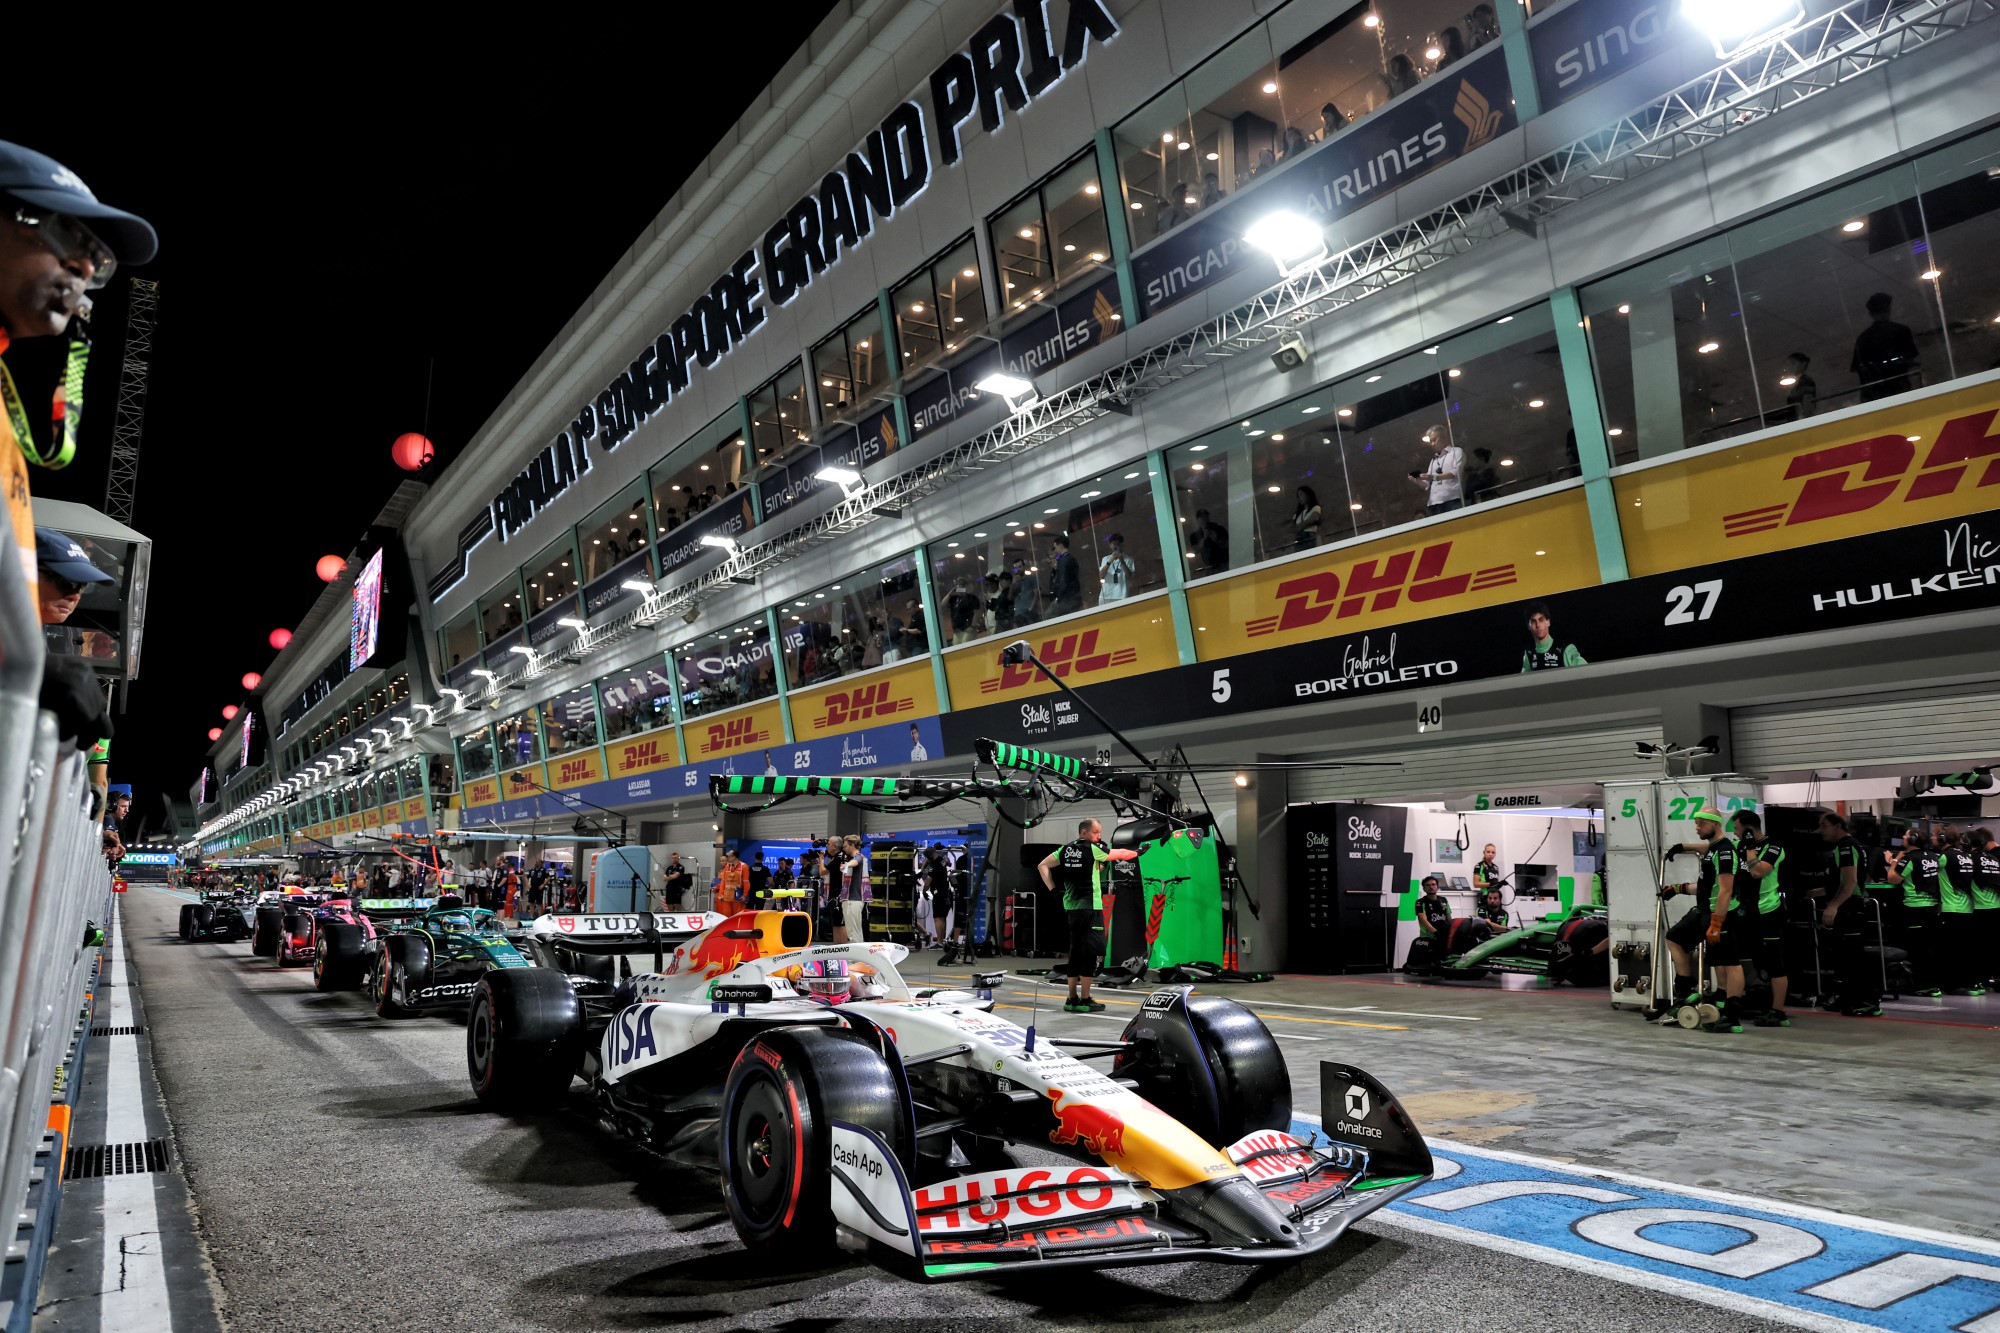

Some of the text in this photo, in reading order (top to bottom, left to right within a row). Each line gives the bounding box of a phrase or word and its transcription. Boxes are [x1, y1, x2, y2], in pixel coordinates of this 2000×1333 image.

[1147, 122, 1447, 306] SINGAP AIRLINES
[494, 432, 578, 543] FORMULA
[596, 248, 768, 453] SINGAPORE
[763, 100, 932, 306] GRAND
[929, 0, 1121, 166] PRIX
[914, 319, 1090, 432] SINGAPO AIRLINES
[831, 436, 880, 467] IRLINES
[1277, 541, 1473, 632] DHL
[588, 589, 618, 613] SINGAPORE
[1664, 579, 1723, 626] 27
[997, 629, 1112, 692] DHL
[1343, 632, 1397, 682] Gabriel
[1212, 669, 1232, 703] 5
[1295, 659, 1459, 697] BORTOLETO
[825, 682, 900, 726] DHL
[1021, 701, 1071, 728] Stake KICK
[1419, 705, 1441, 727] 40
[1057, 713, 1079, 726] SAUBER
[707, 716, 759, 752] DHL
[842, 733, 873, 759] Alexander
[623, 741, 663, 770] DHL
[794, 750, 811, 769] 23
[841, 754, 877, 769] ALBON
[1097, 748, 1111, 764] 39
[560, 759, 591, 783] DHL
[685, 771, 698, 787] 55
[473, 784, 492, 802] DHL
[1475, 794, 1542, 811] 5 GABRIEL
[1621, 798, 1637, 818] 5
[1668, 796, 1705, 821] 27
[1306, 831, 1330, 848] Stake
[1348, 815, 1382, 841] Stake
[121, 853, 170, 864] aramco
[1064, 846, 1083, 859] Stake
[365, 897, 434, 908] aramc
[480, 938, 510, 947] 14
[725, 988, 759, 998] hahnair
[1147, 994, 1174, 1006] NEFT
[607, 1004, 660, 1071] VISA
[975, 1028, 1037, 1050] 30
[754, 1041, 782, 1070] PIRELLI
[1014, 1050, 1073, 1062] VISA
[998, 1079, 1011, 1090] FIA
[1056, 1077, 1112, 1088] PIRELLI
[1077, 1087, 1124, 1098] Mobil
[1337, 1119, 1383, 1139] dynatrace
[833, 1143, 884, 1180] Cash App
[1233, 1133, 1314, 1178] HUGO
[1203, 1164, 1230, 1174] HRC
[916, 1167, 1113, 1233] HUGO
[930, 1217, 1151, 1254] Red Bull
